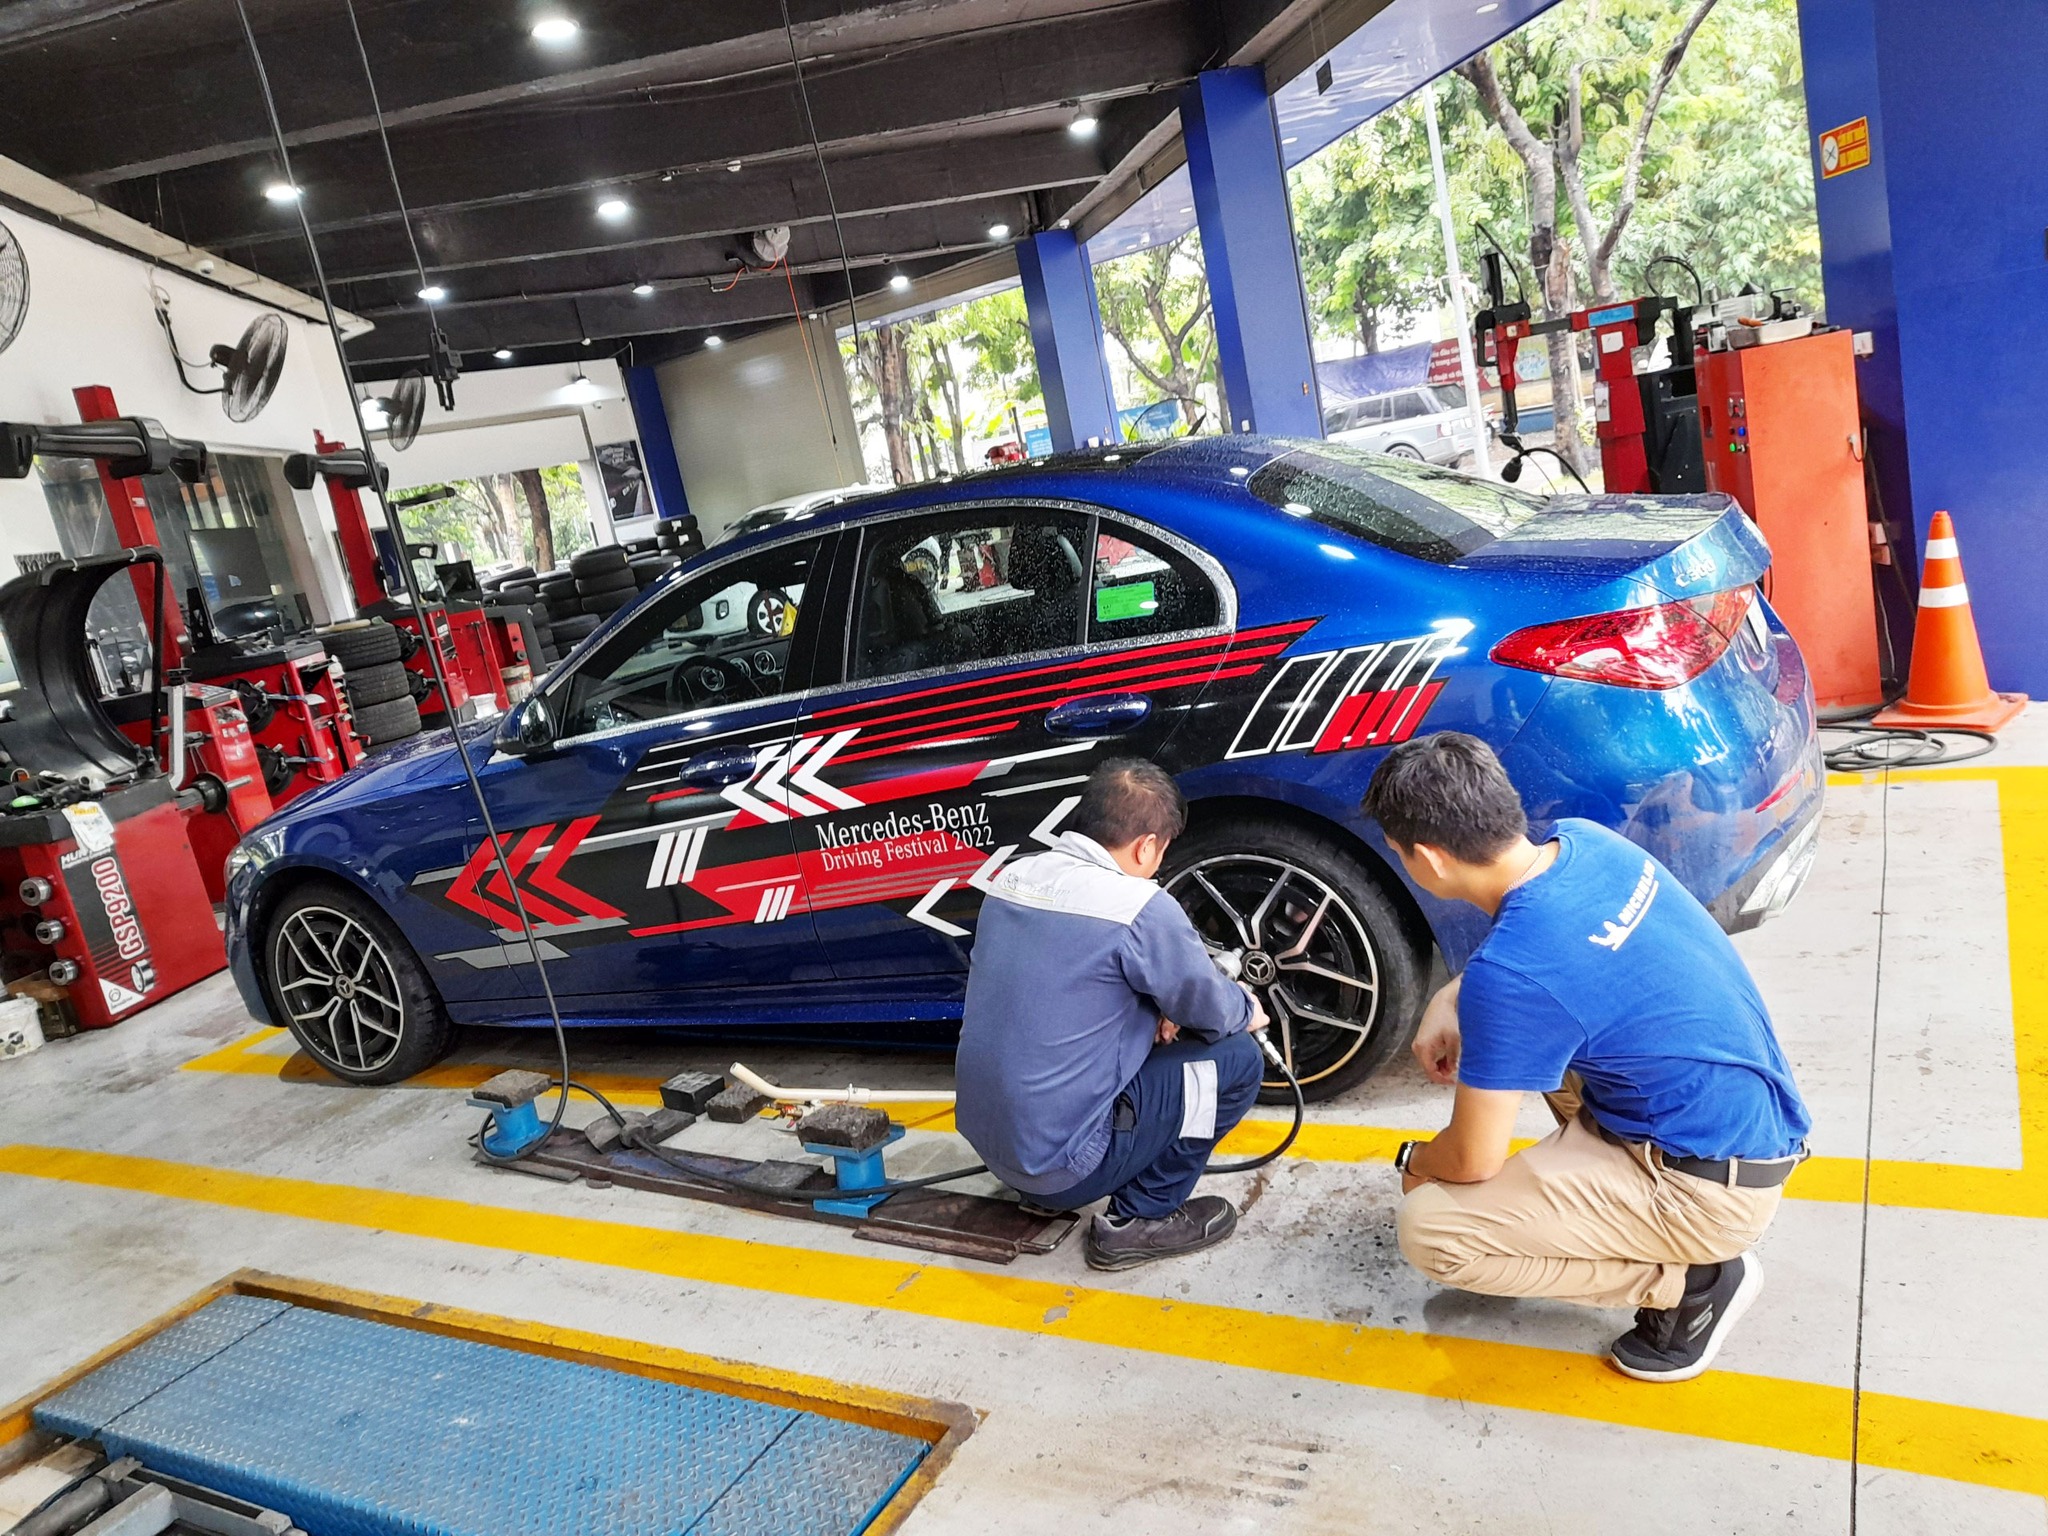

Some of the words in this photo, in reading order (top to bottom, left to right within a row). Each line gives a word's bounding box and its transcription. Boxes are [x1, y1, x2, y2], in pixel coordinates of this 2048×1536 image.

[815, 802, 989, 852] Mercedes-Benz
[821, 847, 883, 872] Driving
[884, 833, 949, 862] Festival
[951, 826, 995, 851] 2022
[91, 856, 145, 960] GSP9200
[1617, 859, 1656, 925] MICHELIN
